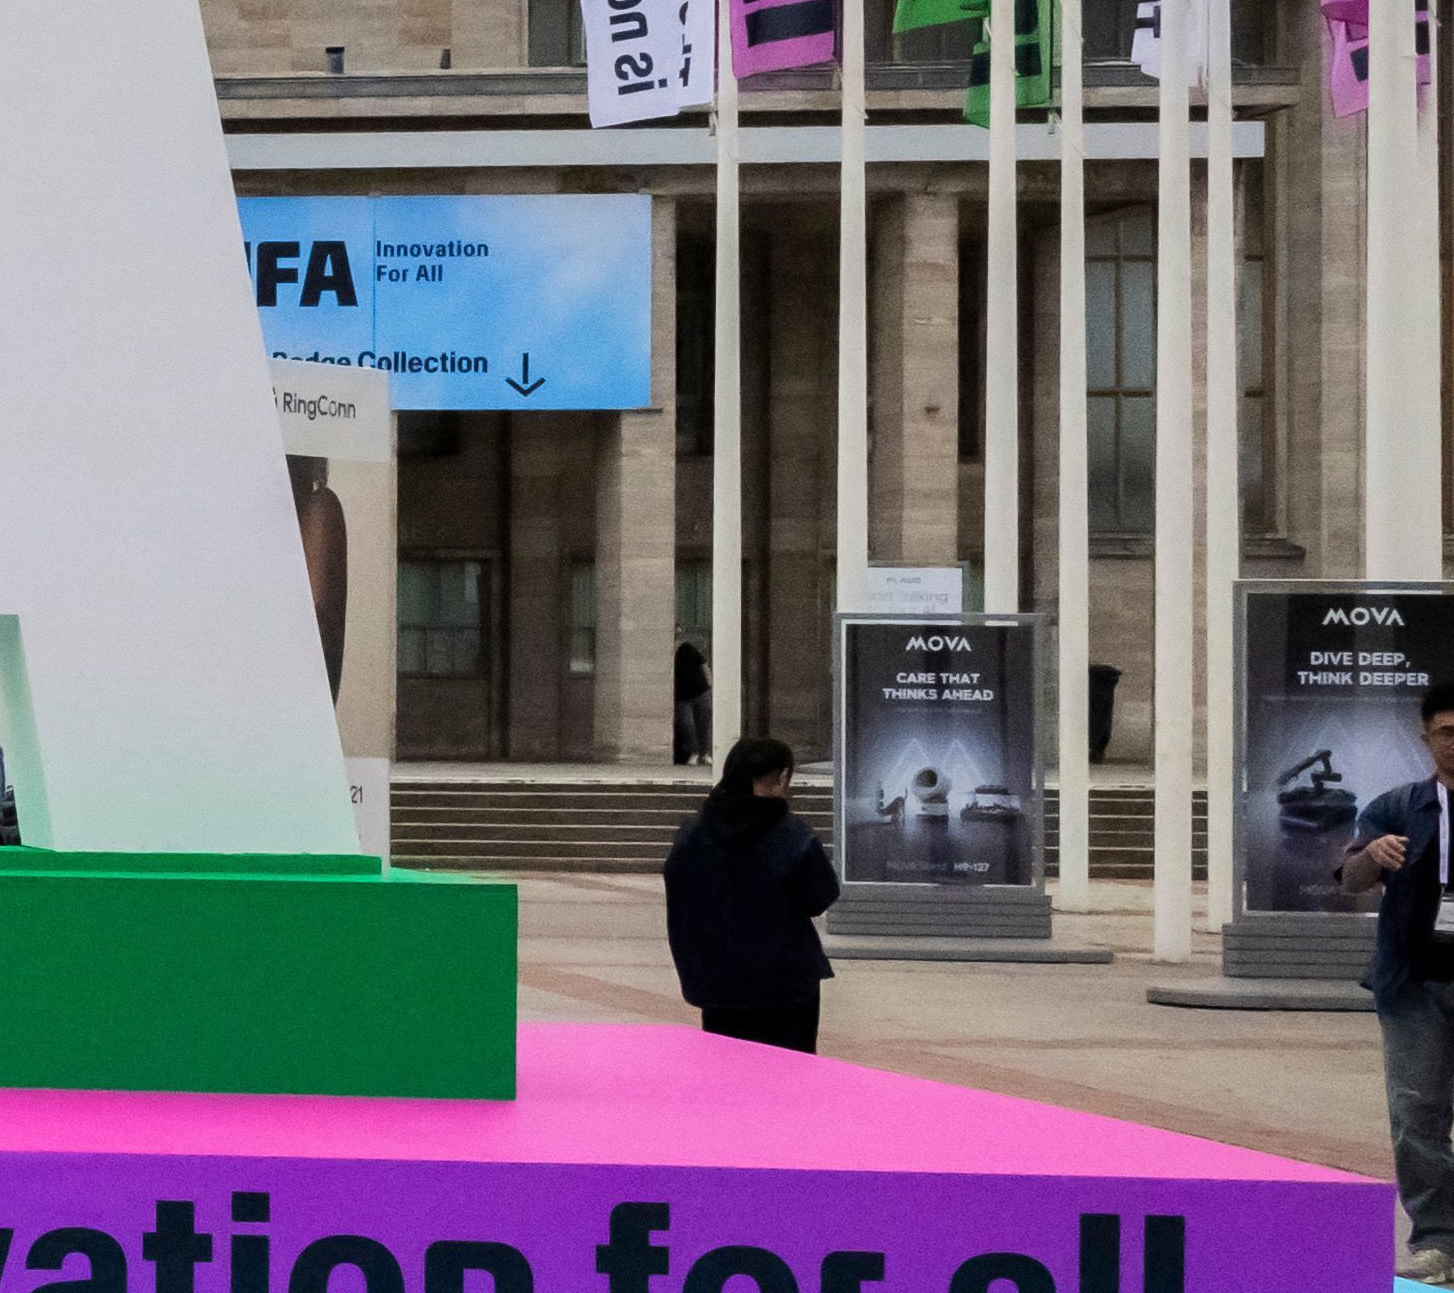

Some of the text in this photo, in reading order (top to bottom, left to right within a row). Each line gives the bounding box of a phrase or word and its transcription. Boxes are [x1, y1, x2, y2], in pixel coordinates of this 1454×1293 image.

[376, 240, 489, 259] Innovation
[242, 241, 357, 307] FA
[376, 264, 443, 283] For All
[357, 350, 488, 373] Collection
[283, 392, 356, 420] RingConn
[1321, 607, 1406, 626] MOVA
[905, 636, 972, 652] MOVA
[1310, 651, 1411, 668] DIVE DEEP,
[896, 672, 980, 684] CARE THAT
[1297, 671, 1429, 686] THINK DEEPER
[882, 688, 994, 701] THINKS AHEAD
